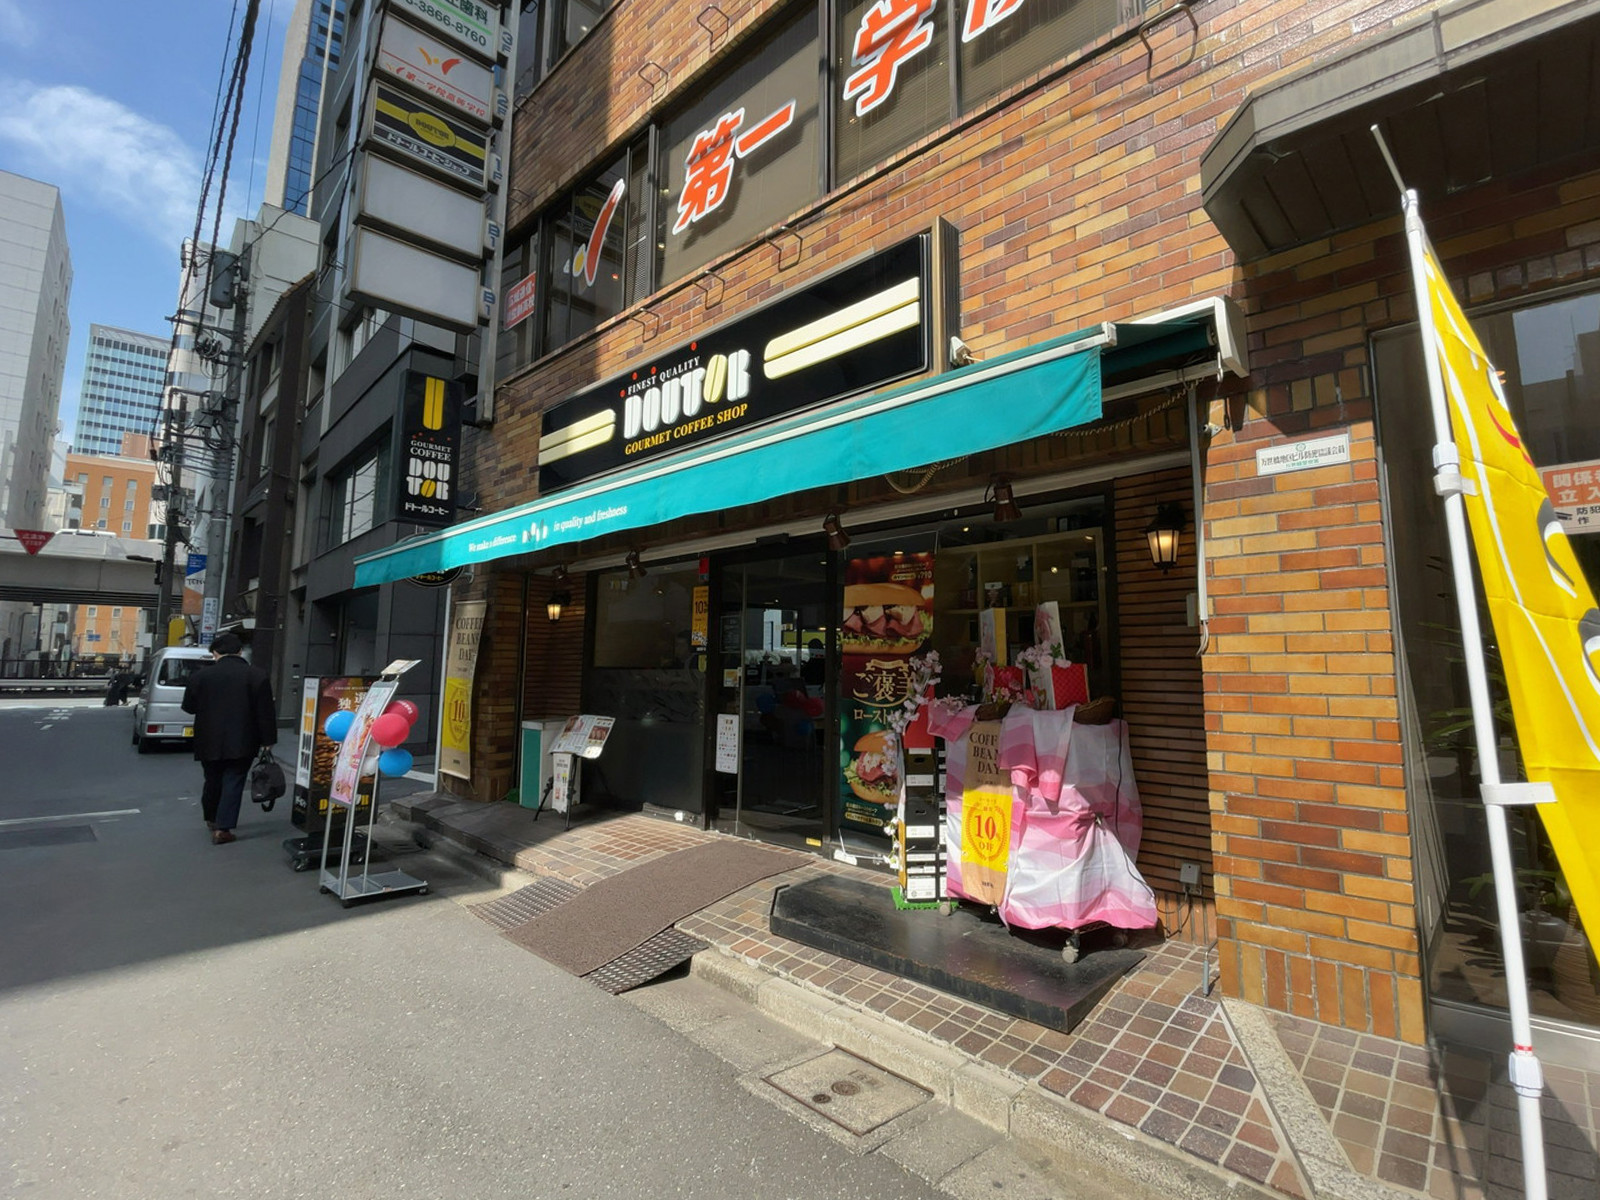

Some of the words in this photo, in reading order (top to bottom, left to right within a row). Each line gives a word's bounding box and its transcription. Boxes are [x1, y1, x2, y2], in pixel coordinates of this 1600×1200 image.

[405, 0, 486, 47] -3866-8760
[627, 375, 657, 395] FINEST
[659, 355, 701, 383] QUALITY
[623, 348, 751, 440] DOUTOR
[625, 430, 672, 455] GOURMET
[673, 414, 715, 439] COFFEE
[716, 403, 748, 424] SHOP
[410, 440, 452, 453] GOURMET
[410, 446, 451, 462] COFFEE
[405, 501, 449, 516] ドトールコーヒー
[560, 516, 583, 533] quality
[583, 510, 596, 525] and
[596, 505, 628, 522] freshness
[969, 732, 998, 747] COFF
[977, 760, 1000, 775] DAY
